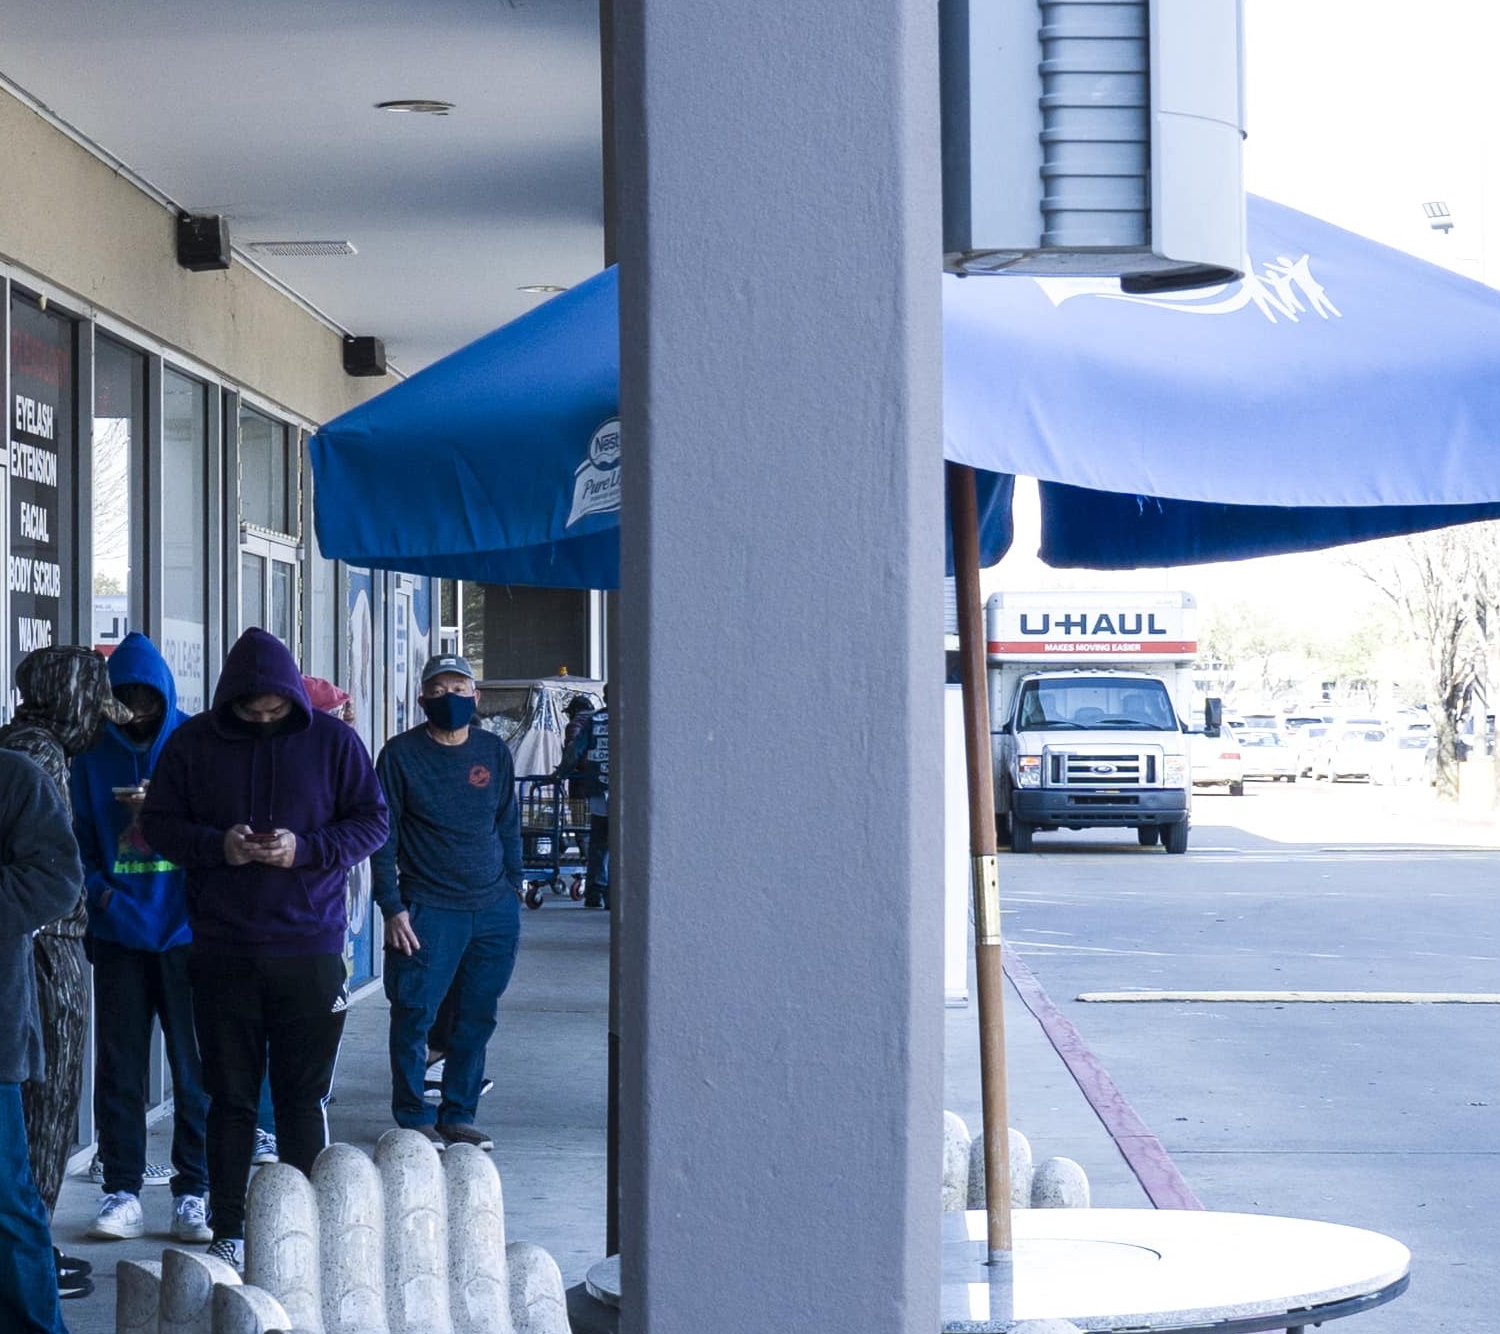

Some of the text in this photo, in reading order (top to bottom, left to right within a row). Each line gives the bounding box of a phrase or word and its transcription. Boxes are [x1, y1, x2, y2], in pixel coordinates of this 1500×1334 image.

[15, 394, 54, 441] EYELASH
[595, 431, 621, 454] Nest
[11, 440, 57, 488] EXTENSION
[20, 501, 50, 543] FACIAL
[9, 555, 61, 598] BODY SCRUB
[18, 617, 52, 653] WAXING
[1020, 613, 1167, 635] U-HAUL
[1044, 643, 1141, 652] MAKES MOVING EASIER
